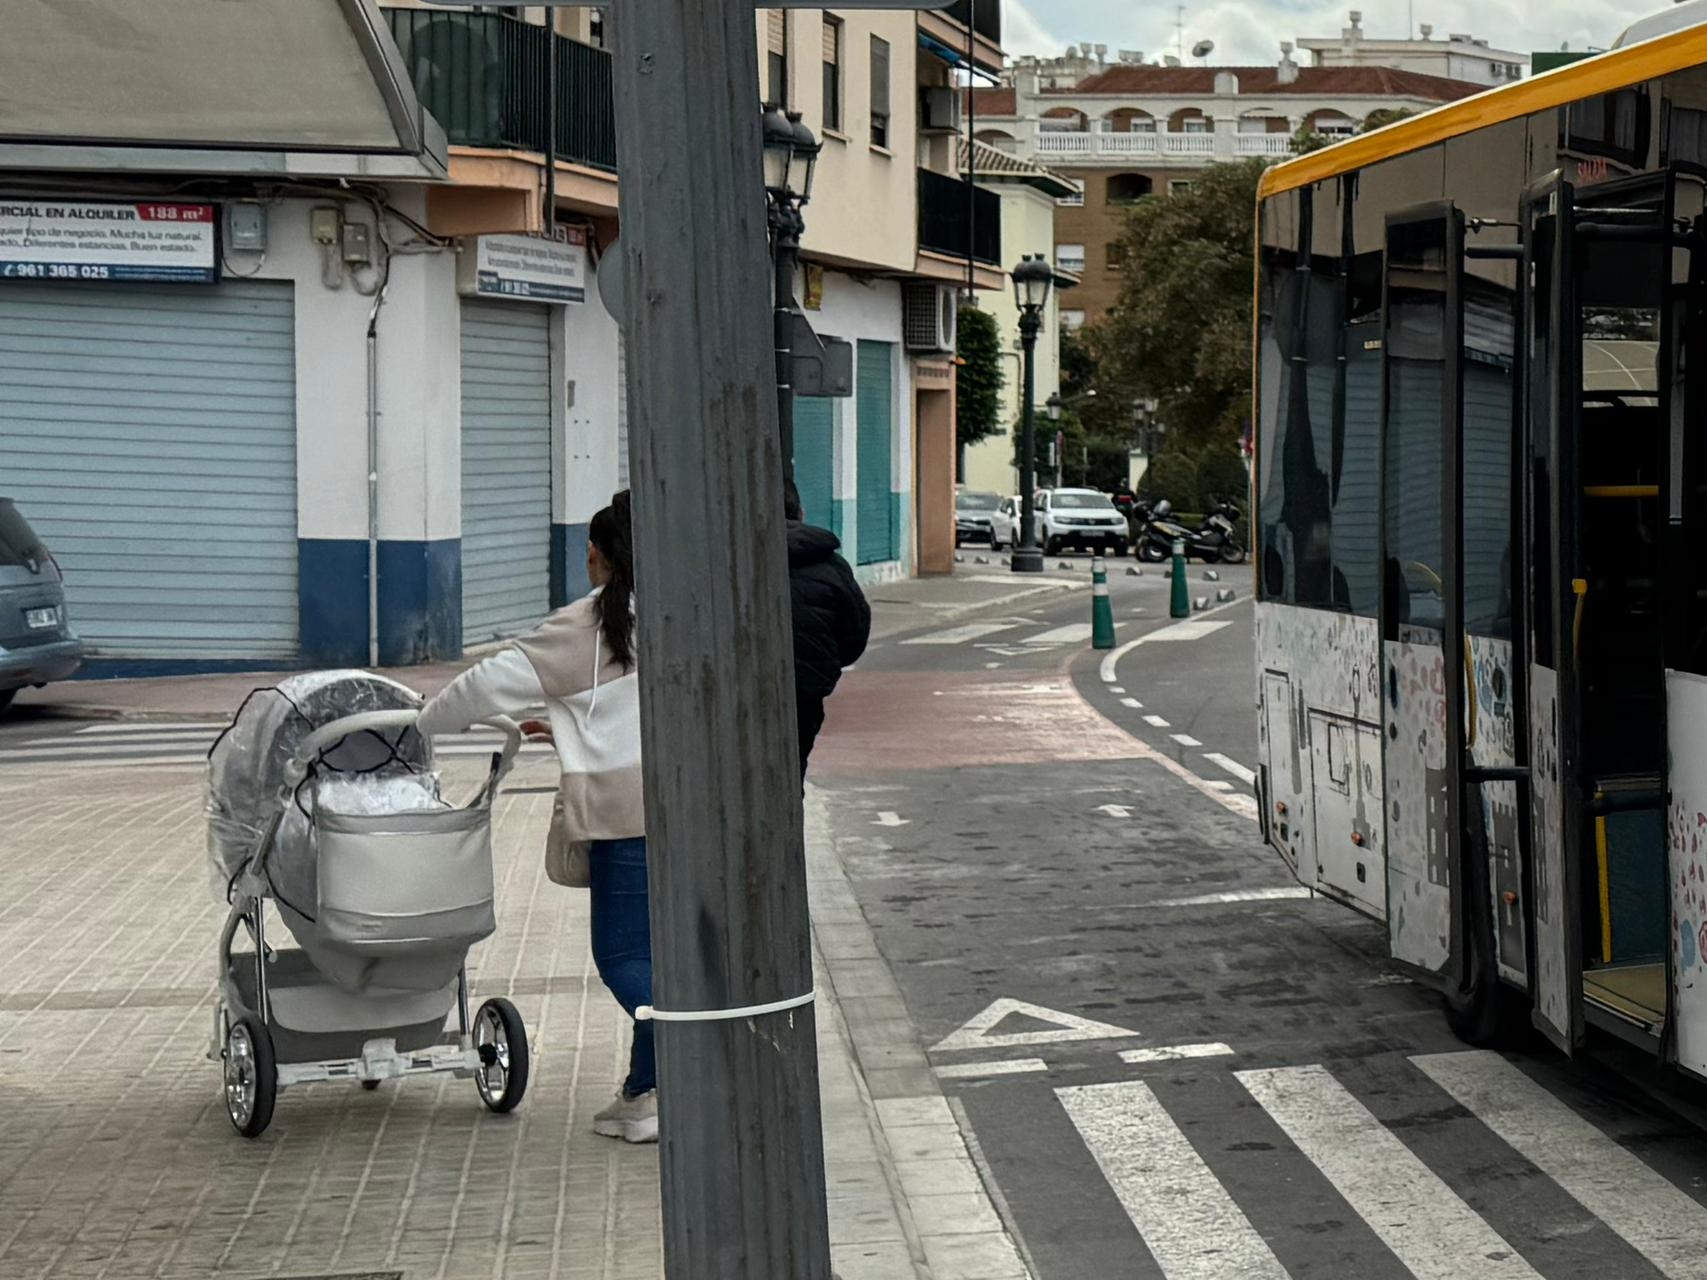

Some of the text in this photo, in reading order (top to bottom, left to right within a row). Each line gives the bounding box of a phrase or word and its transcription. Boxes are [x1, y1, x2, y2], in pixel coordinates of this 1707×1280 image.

[0, 206, 42, 218] RCIAL
[46, 208, 65, 218] EN
[68, 208, 136, 220] ALQUILER
[110, 229, 146, 239] Mucha
[17, 264, 45, 276] 961
[81, 265, 109, 278] 025
